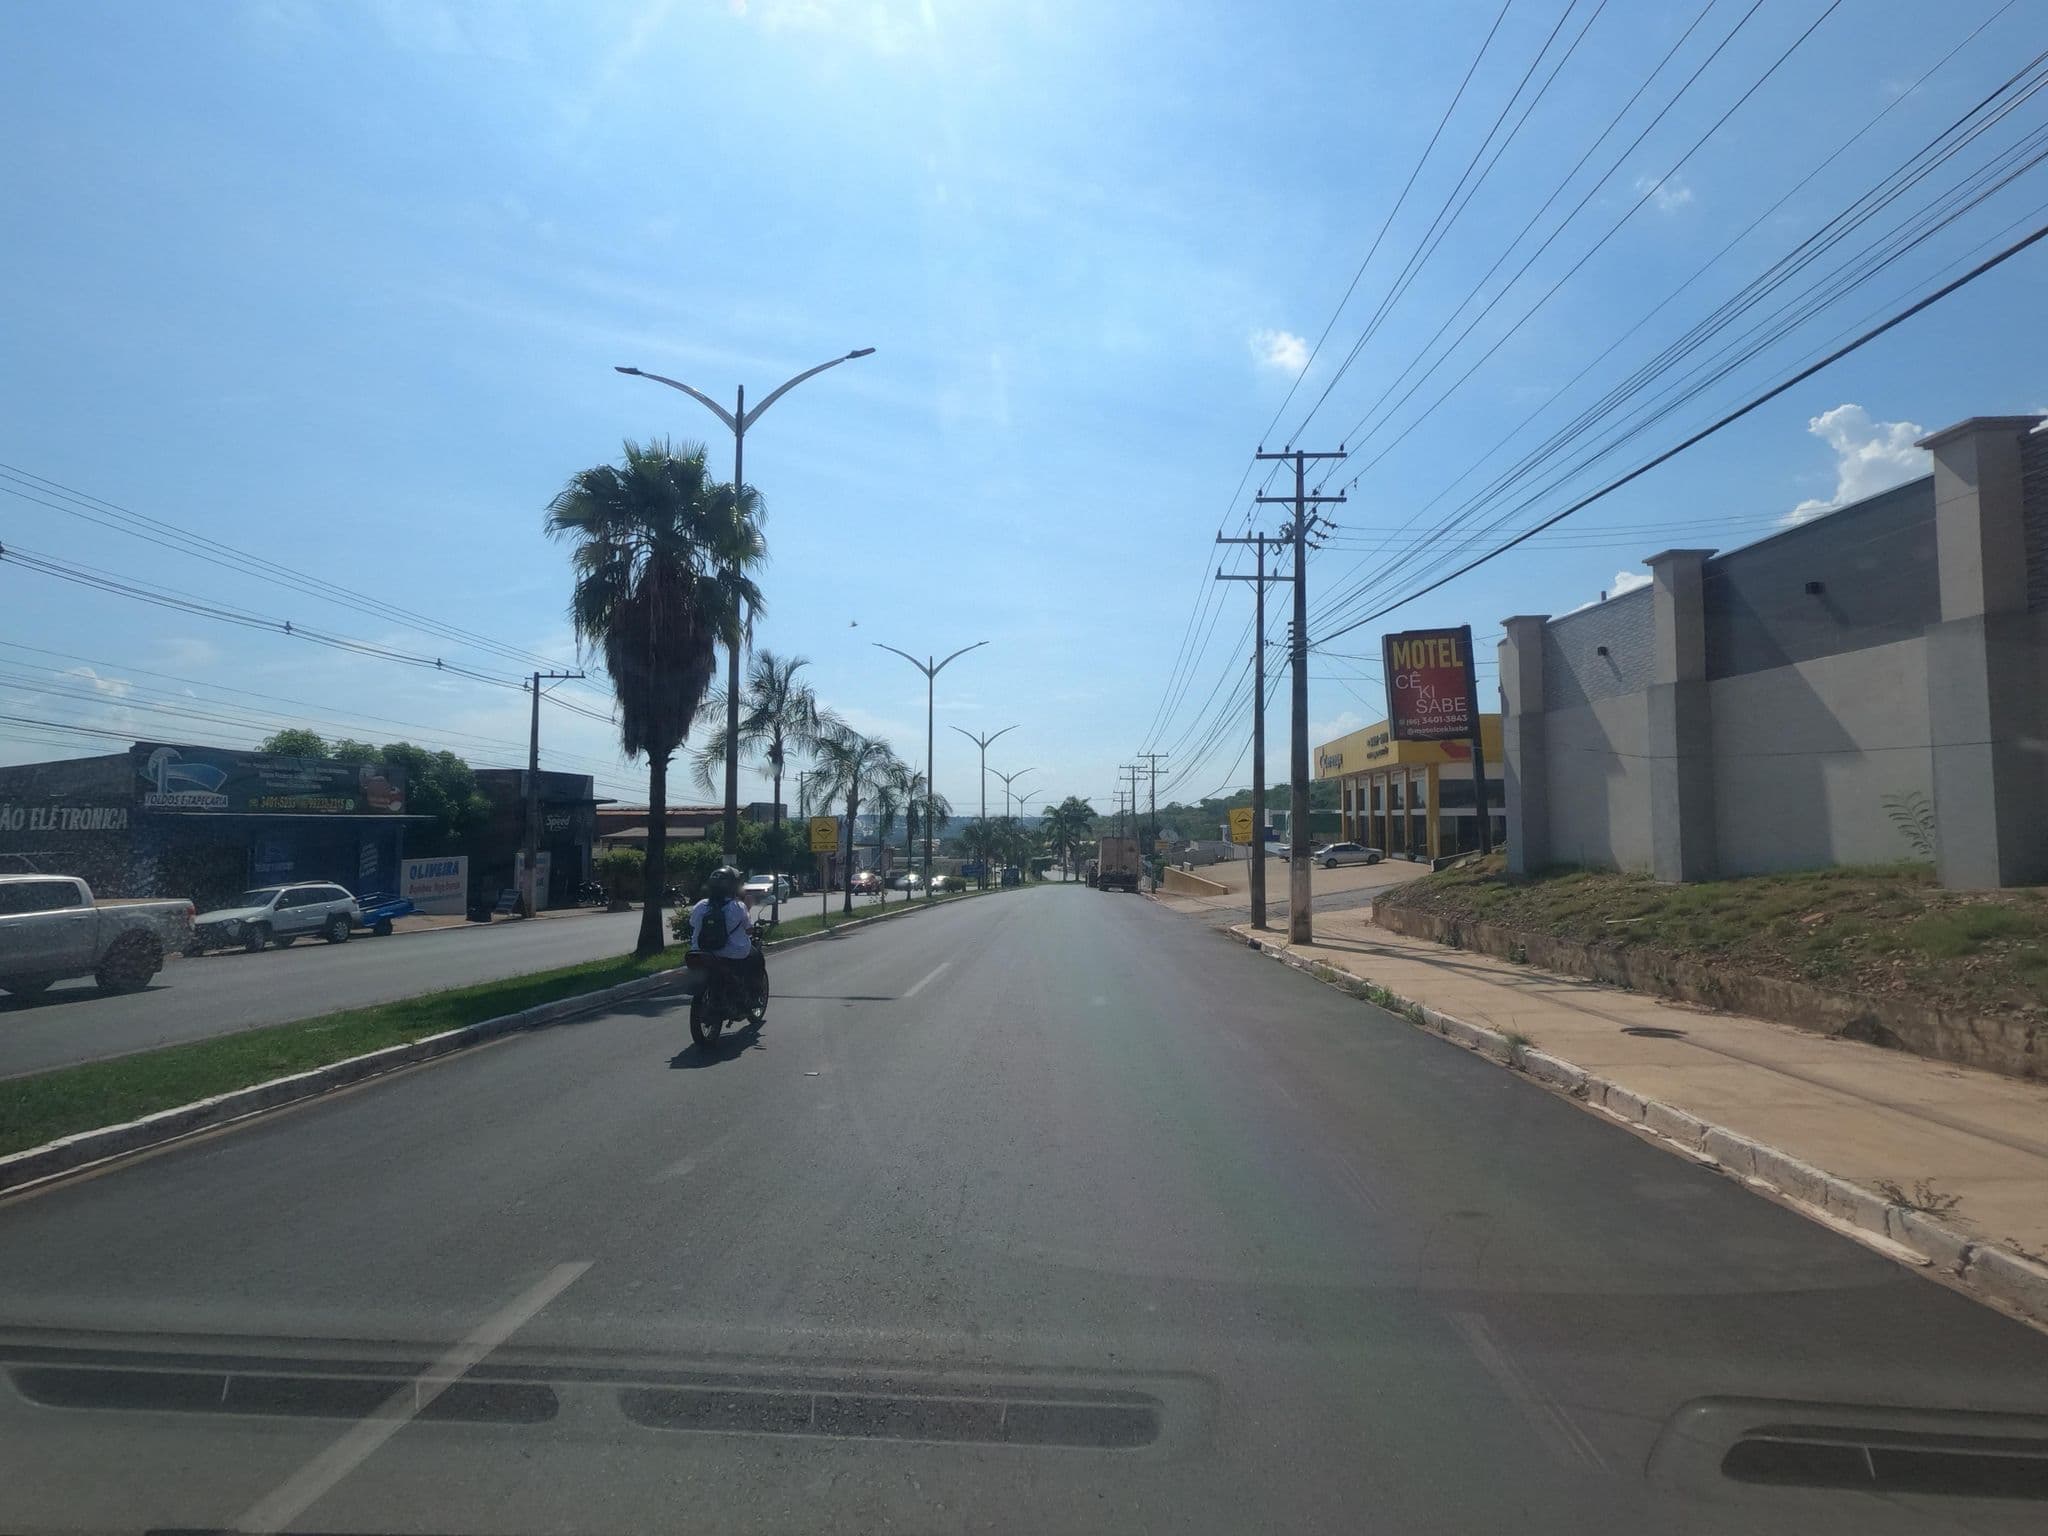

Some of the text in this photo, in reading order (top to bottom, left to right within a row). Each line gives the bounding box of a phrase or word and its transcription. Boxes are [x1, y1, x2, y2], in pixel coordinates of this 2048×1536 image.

[1392, 638, 1464, 671] MOTEL
[1395, 671, 1421, 690] CÊ
[1420, 685, 1435, 699] KI
[1416, 697, 1467, 714] SABE
[1422, 714, 1468, 724] 3401-3843
[546, 814, 571, 831] Speed
[410, 861, 460, 880] OLIVEIRA
